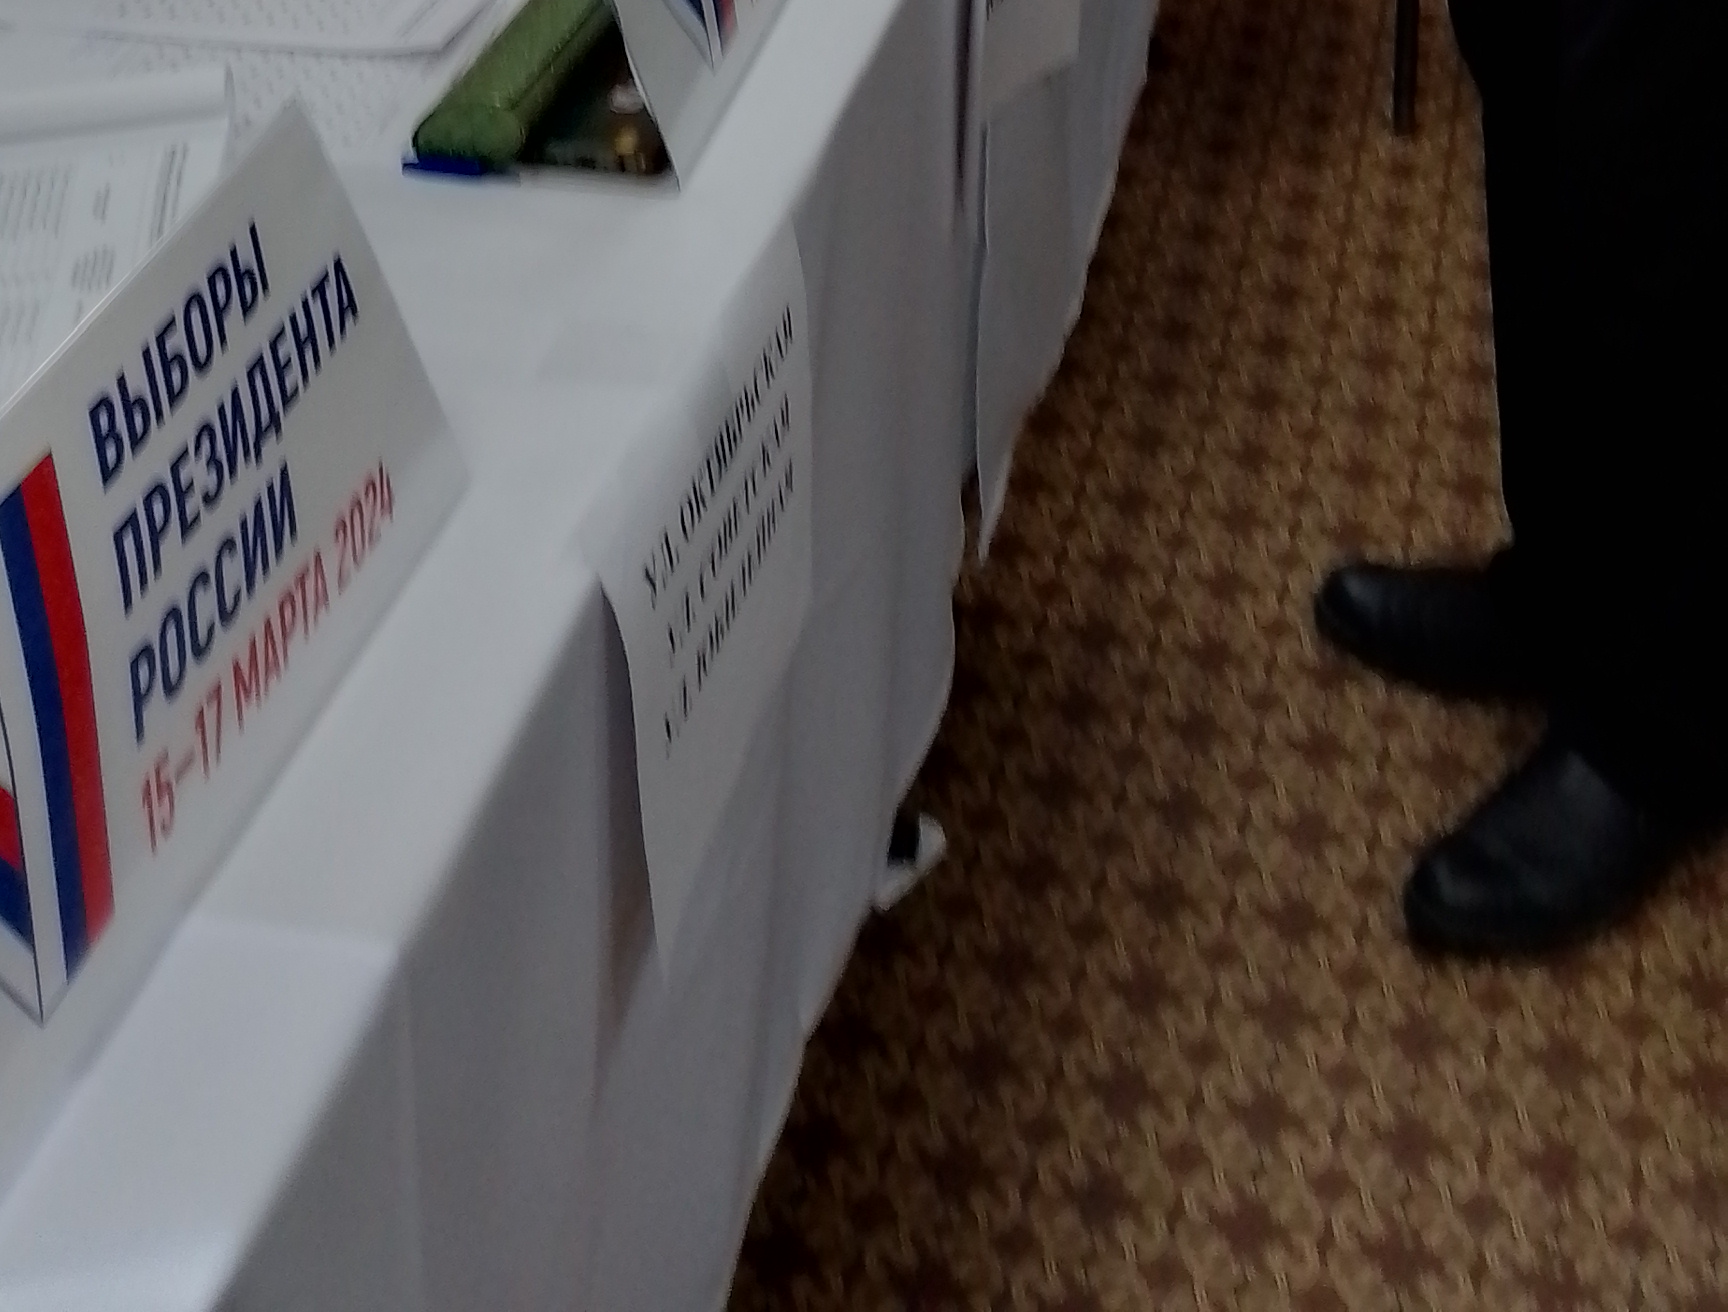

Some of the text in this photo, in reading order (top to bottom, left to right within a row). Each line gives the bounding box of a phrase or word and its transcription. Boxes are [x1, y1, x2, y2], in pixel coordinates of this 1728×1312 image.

[88, 221, 271, 491] ВЫБОРЫ
[112, 251, 359, 620] ПРЕЗИДЕНТА
[126, 462, 298, 743] РОССИИ
[232, 566, 331, 733] МАРТА
[333, 458, 396, 596] 2024
